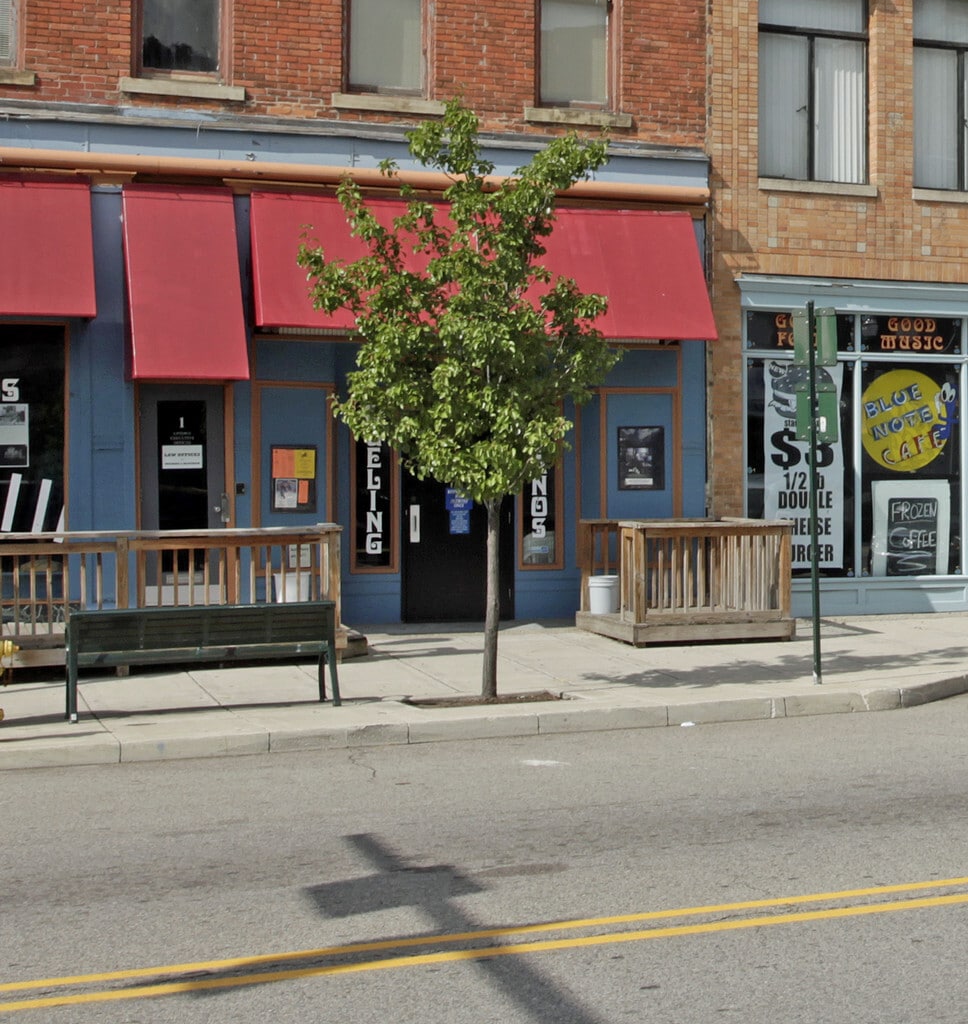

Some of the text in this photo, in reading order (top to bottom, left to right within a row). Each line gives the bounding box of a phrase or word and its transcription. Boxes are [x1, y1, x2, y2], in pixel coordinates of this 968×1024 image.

[888, 317, 936, 332] GOOD
[880, 335, 944, 350] MUSIC
[864, 384, 923, 419] BLUE
[178, 416, 185, 428] 1
[872, 404, 934, 441] NOTE
[783, 472, 807, 490] 1/2
[778, 491, 833, 509] DOULE
[891, 501, 938, 522] FROZEN
[780, 517, 832, 536] HESE
